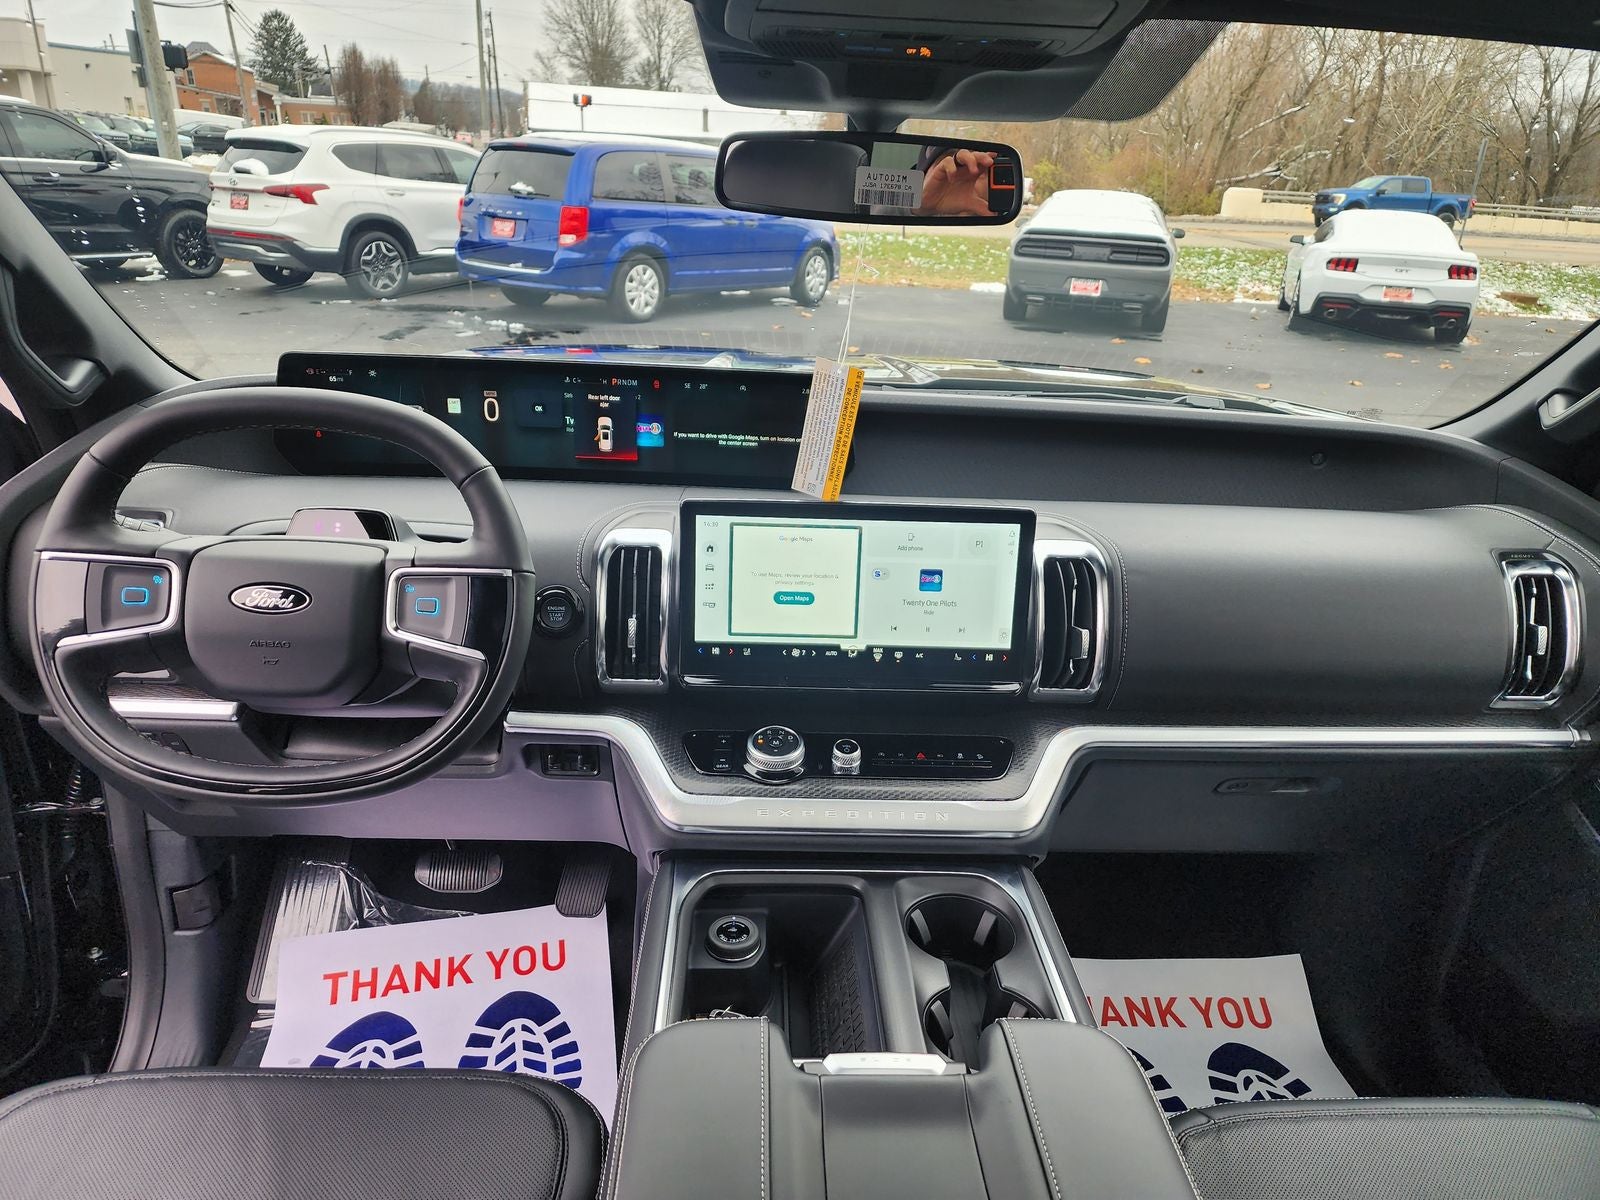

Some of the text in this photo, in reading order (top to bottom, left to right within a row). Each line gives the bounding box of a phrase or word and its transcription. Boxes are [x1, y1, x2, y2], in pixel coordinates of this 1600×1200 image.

[866, 172, 908, 183] AUTODIM
[484, 398, 500, 422] 0
[903, 599, 925, 607] Twenty
[249, 639, 291, 649] AIRBAG
[756, 808, 951, 822] EXPEDITION
[322, 939, 566, 1006] THANK YOU
[1087, 996, 1272, 1029] ANK YOU
